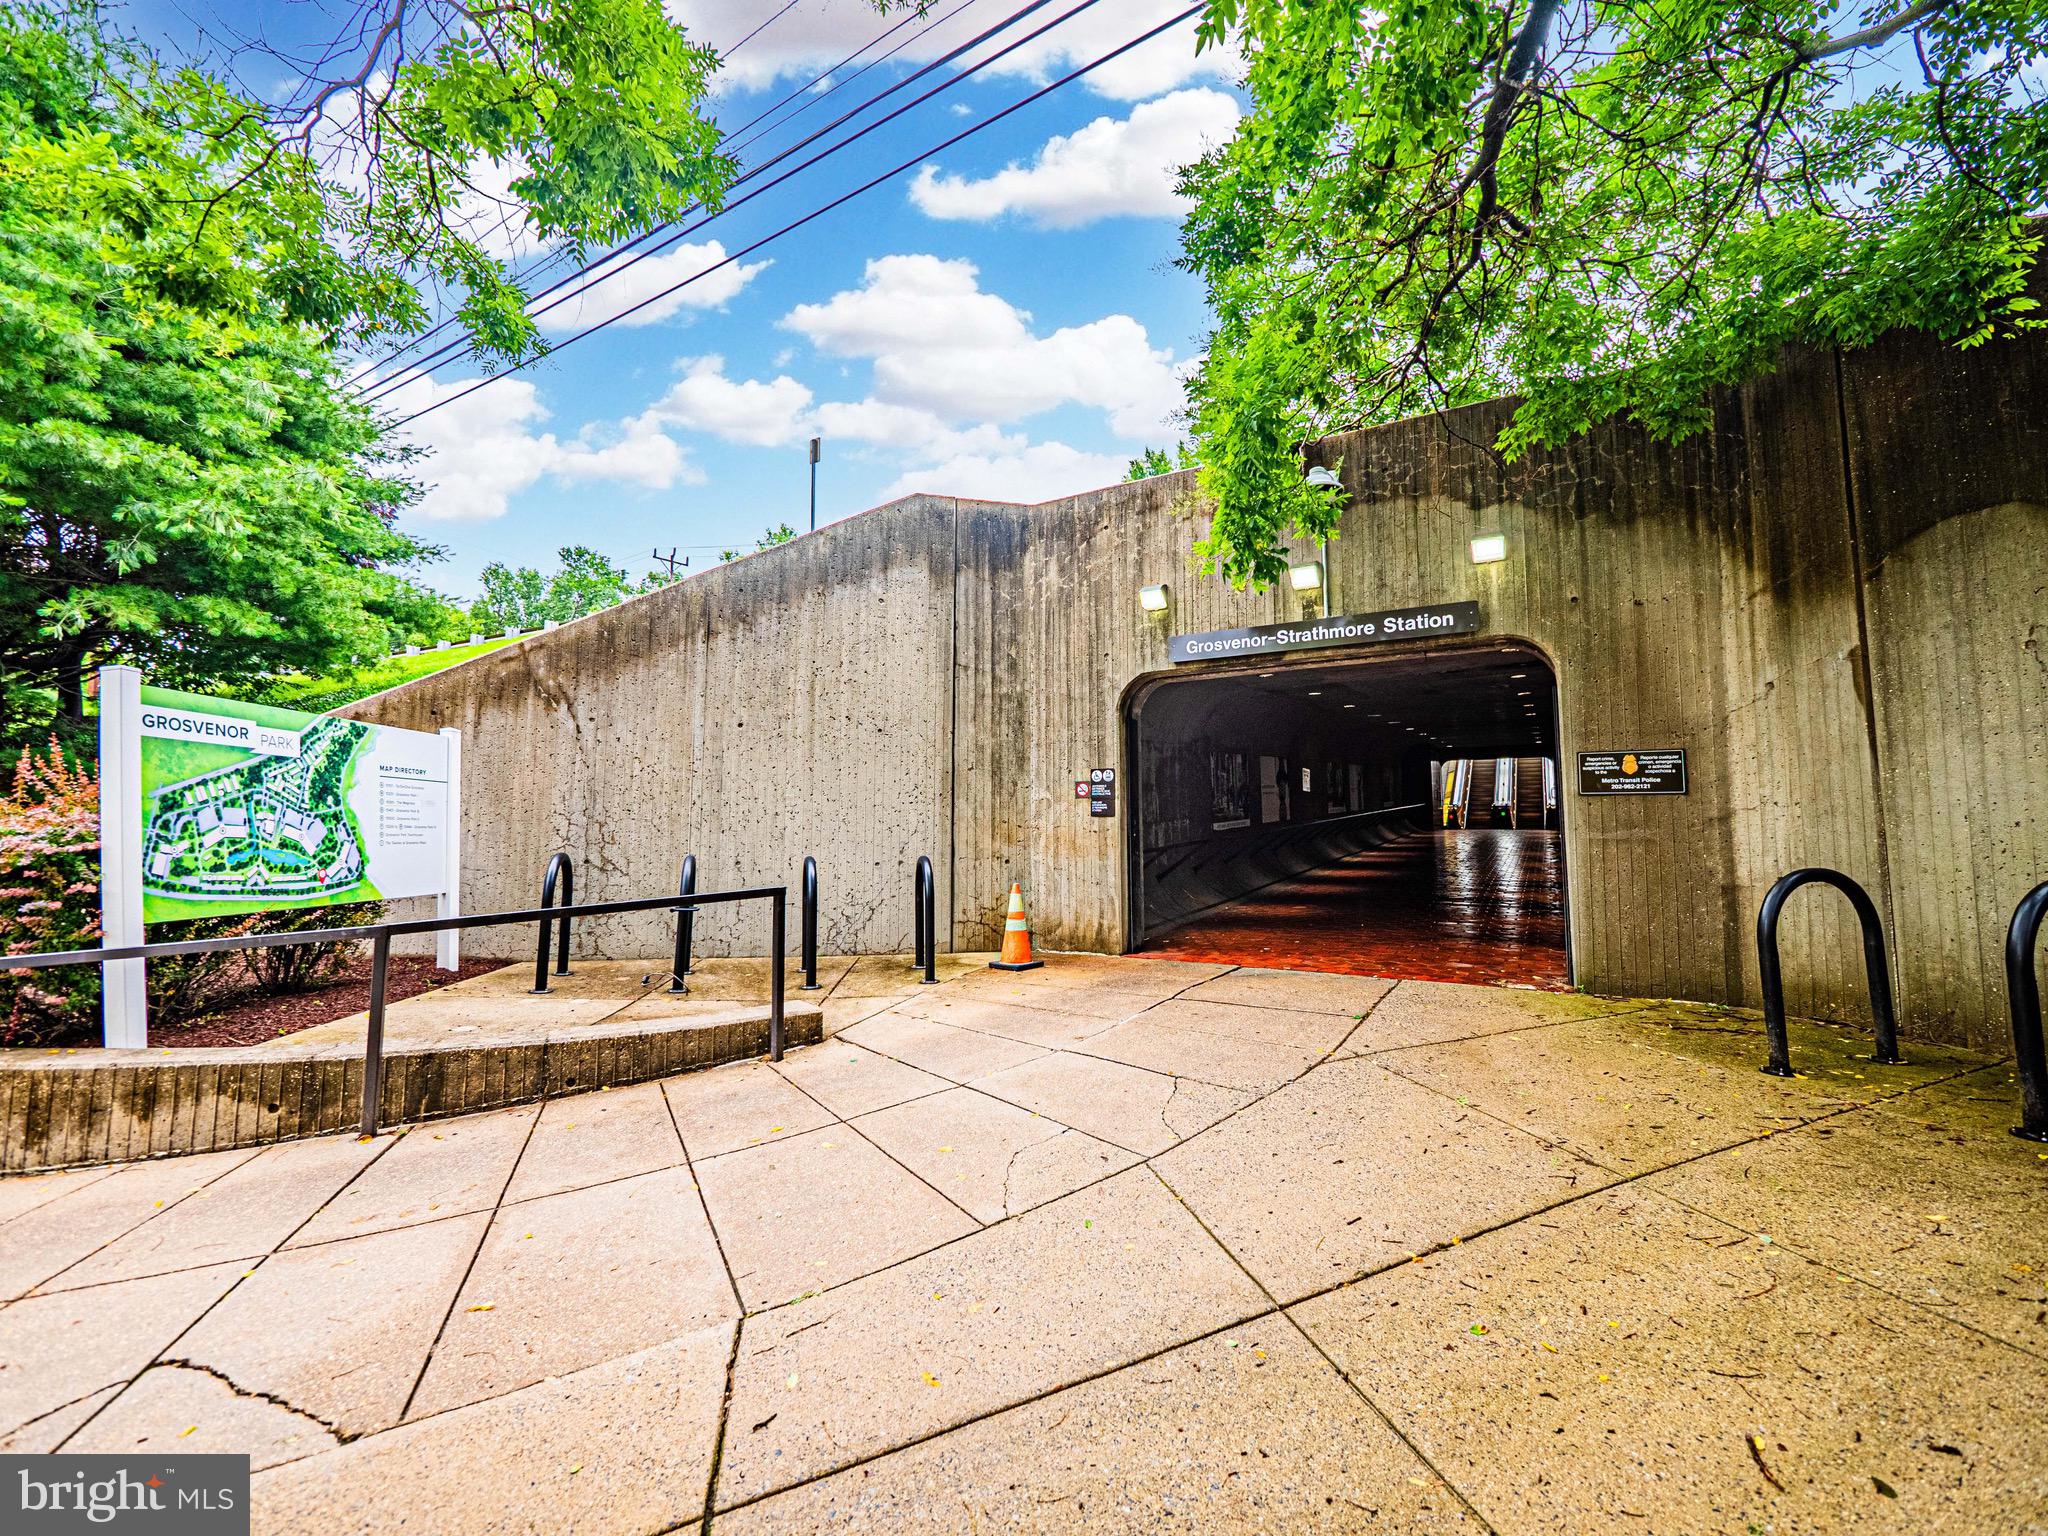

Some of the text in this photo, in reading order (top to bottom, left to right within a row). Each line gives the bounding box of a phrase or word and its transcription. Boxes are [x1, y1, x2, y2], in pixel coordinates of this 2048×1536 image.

[1186, 613, 1454, 654] Grosvenor-Strathmore Station
[142, 713, 295, 750] GROSVENOR PARK
[395, 766, 427, 775] DIRECTORY
